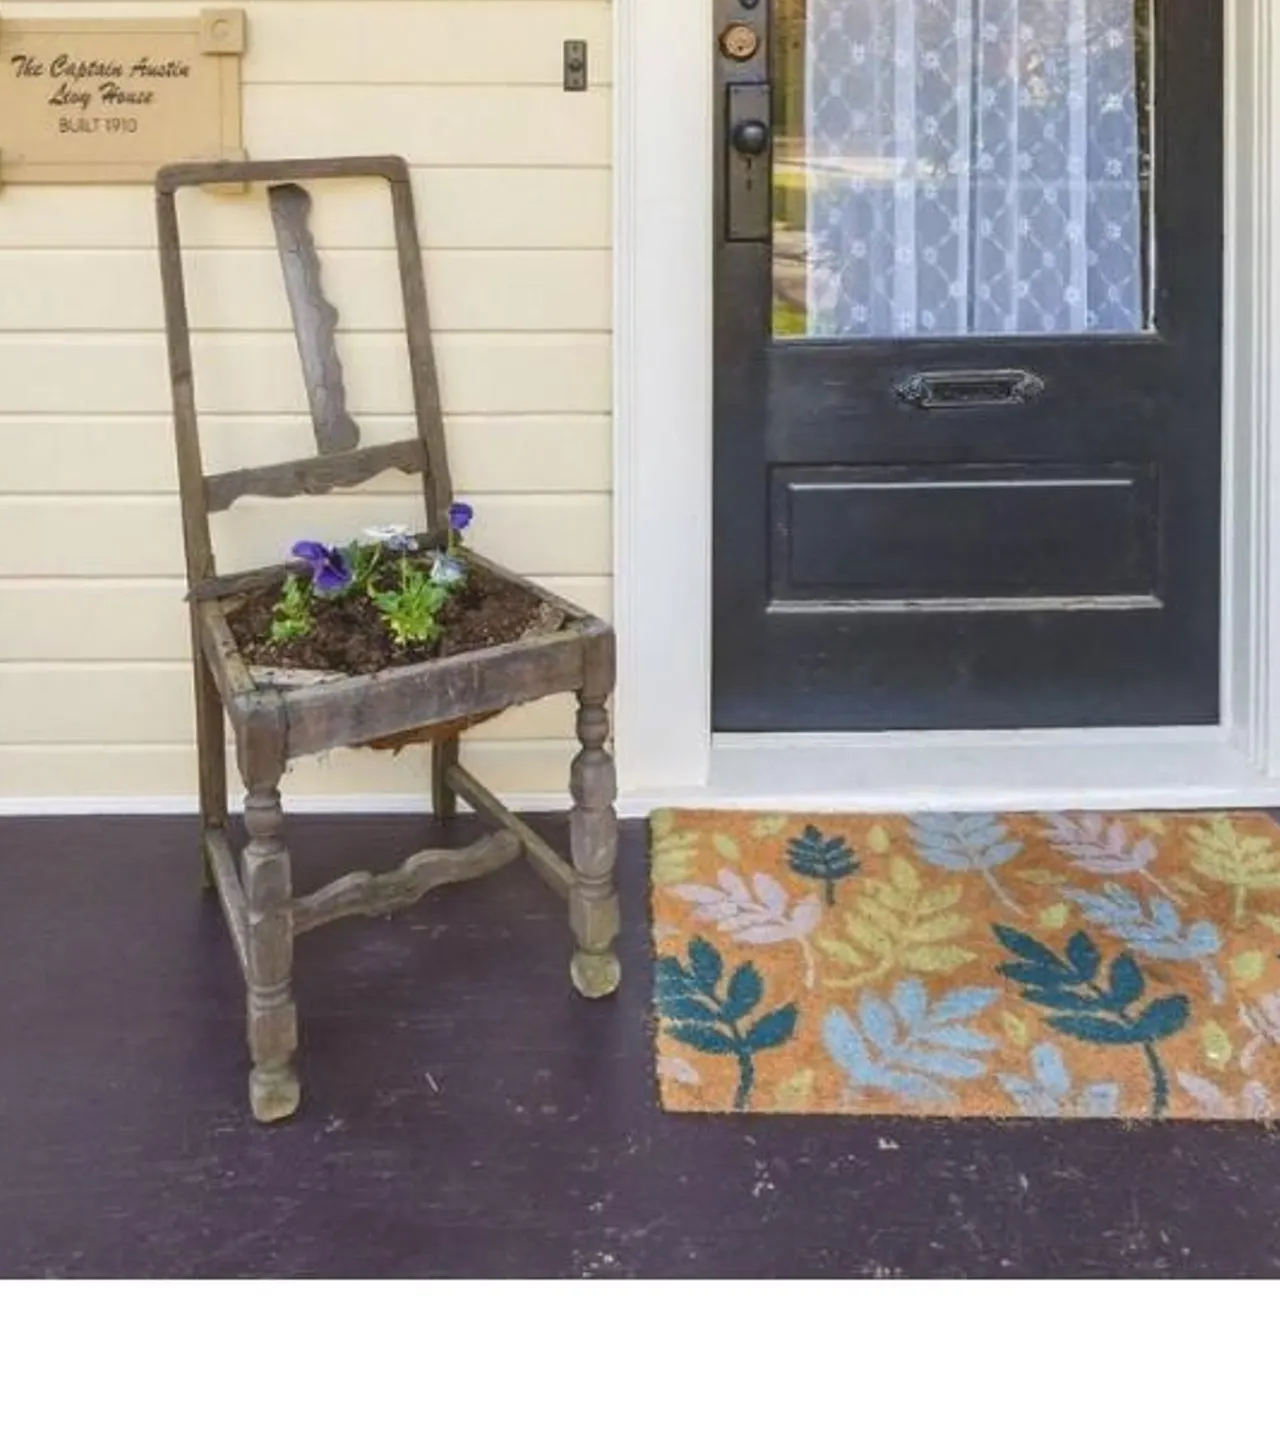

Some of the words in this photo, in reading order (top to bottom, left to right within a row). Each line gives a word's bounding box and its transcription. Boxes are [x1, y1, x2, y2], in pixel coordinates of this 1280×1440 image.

[10, 54, 44, 79] The
[49, 53, 124, 81] Captain
[129, 56, 191, 79] Austin
[97, 80, 155, 105] House
[58, 117, 101, 134] BUILT
[103, 117, 138, 134] 1910
